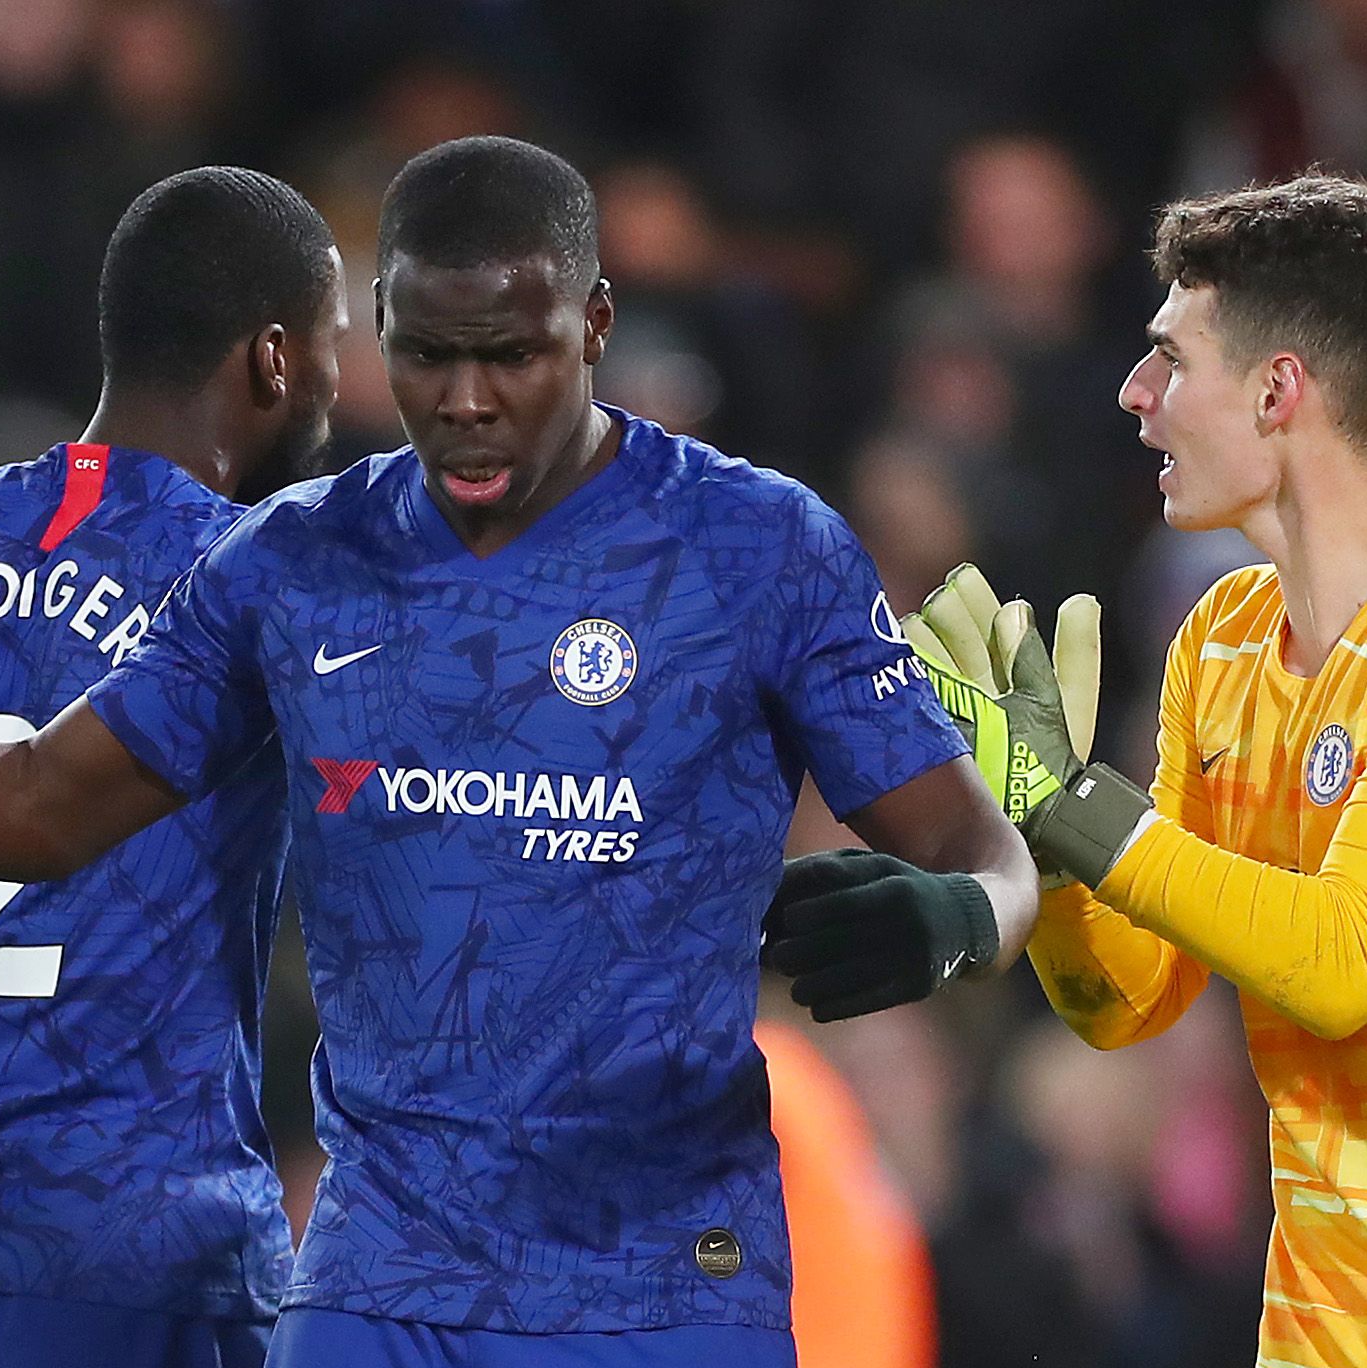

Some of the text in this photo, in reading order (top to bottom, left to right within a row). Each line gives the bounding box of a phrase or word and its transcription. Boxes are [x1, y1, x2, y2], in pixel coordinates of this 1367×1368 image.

[74, 458, 100, 470] CFC
[566, 622, 622, 643] CHELSEA
[377, 766, 644, 822] YOKOHAMA
[1008, 741, 1030, 824] adidas
[521, 827, 640, 864] TYRES
